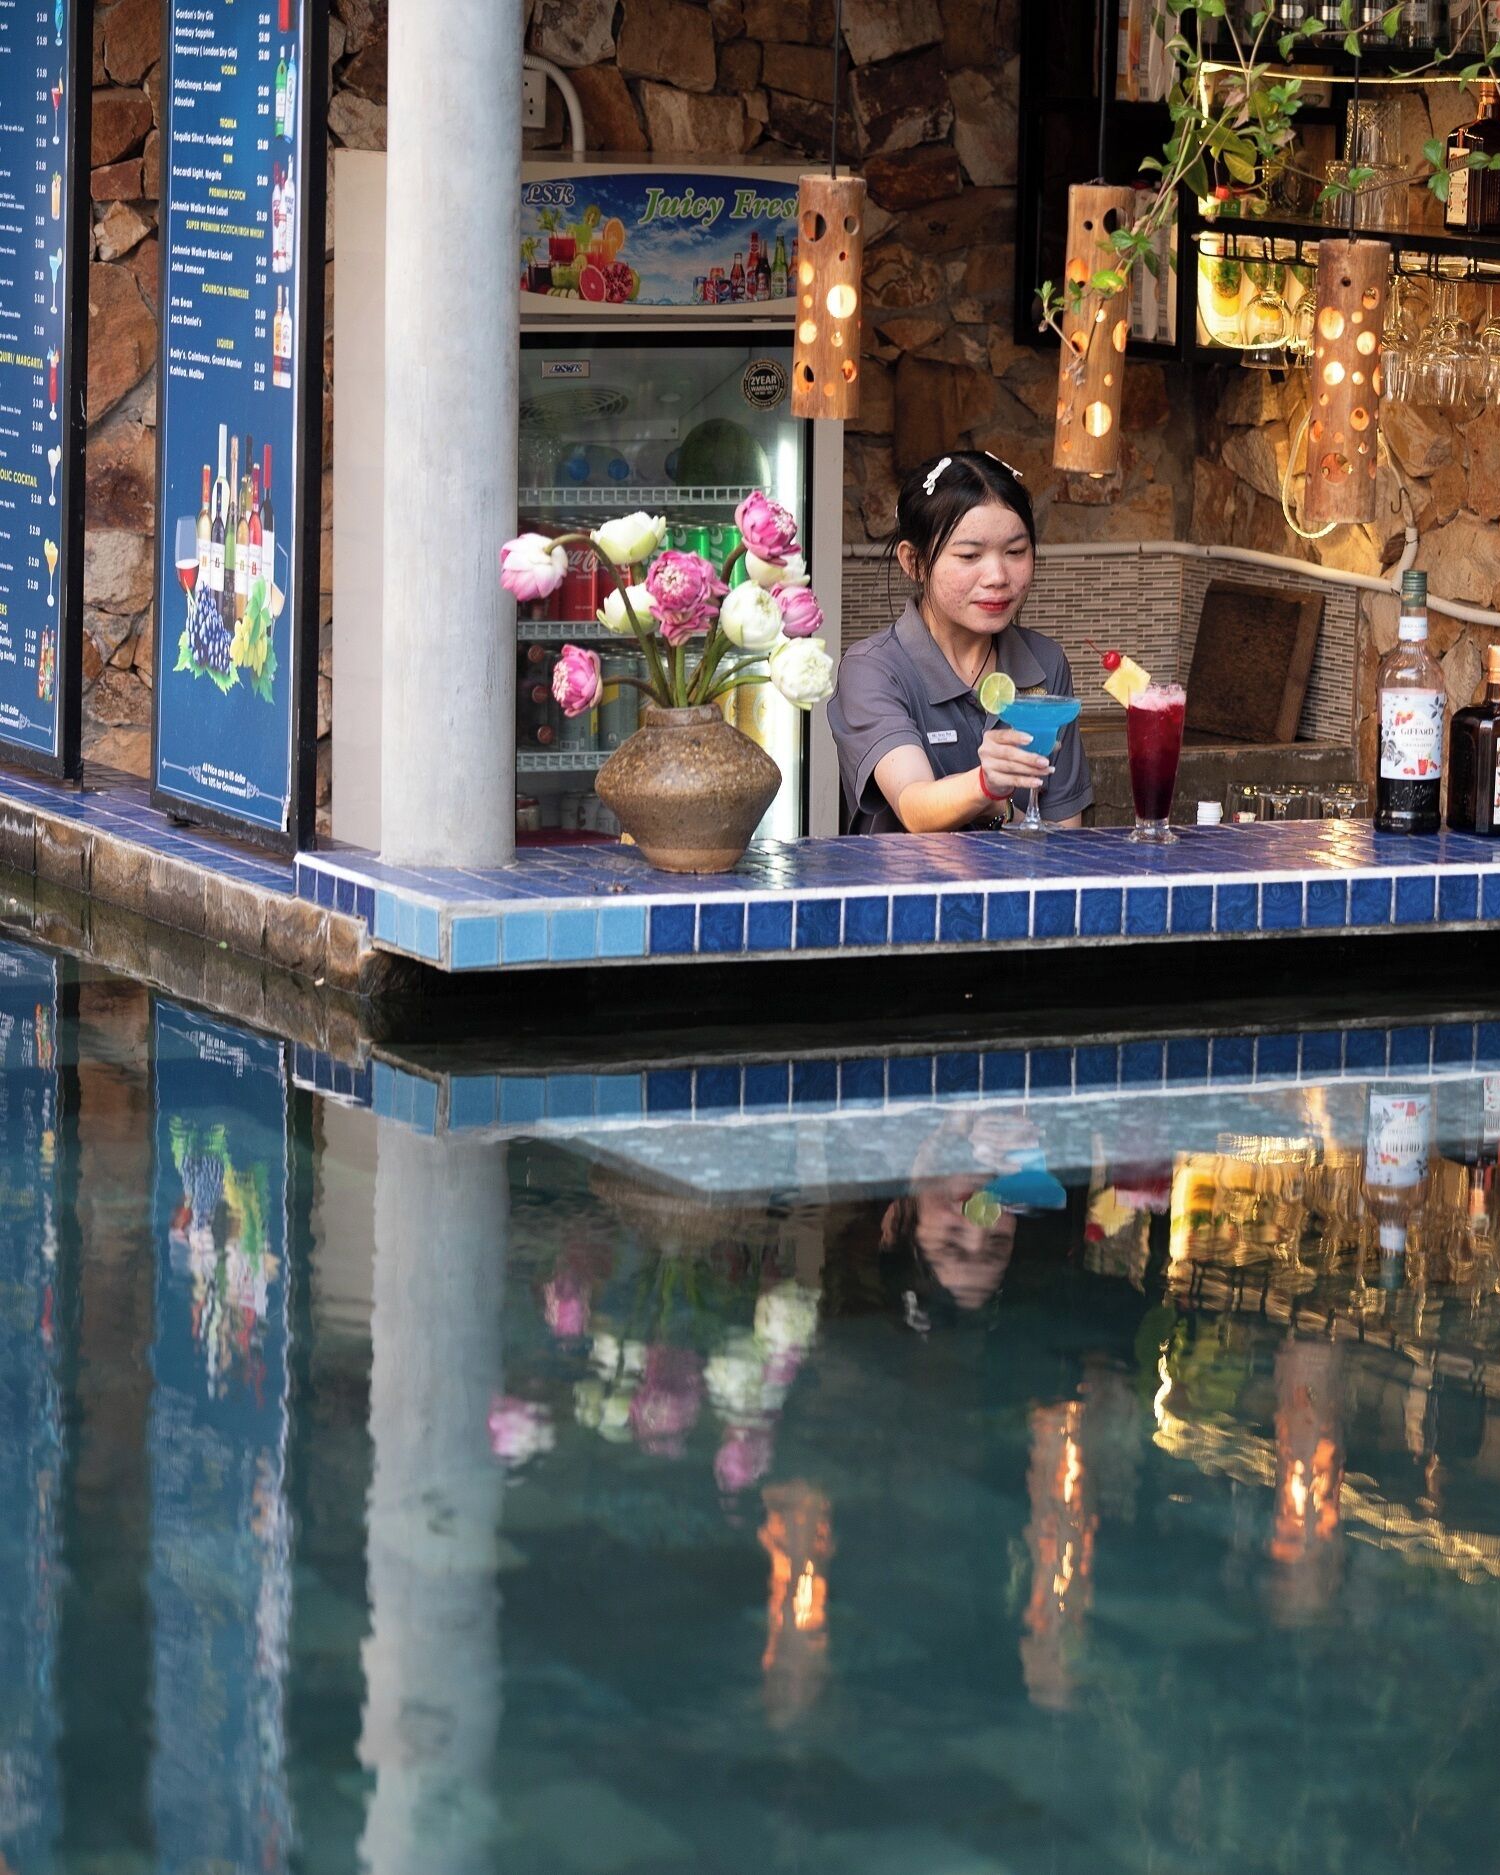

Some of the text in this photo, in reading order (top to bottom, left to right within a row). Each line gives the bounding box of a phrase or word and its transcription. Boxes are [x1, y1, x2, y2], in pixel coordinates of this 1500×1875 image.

[175, 9, 214, 22] Gordon's Dry Gin
[175, 27, 215, 39] Bombay Sapphire
[175, 44, 199, 56] Tanqueray
[220, 47, 228, 59] Dry
[221, 65, 237, 76] VODKA
[203, 81, 222, 92] Smirnoff
[174, 97, 195, 108] Absolute
[220, 118, 237, 129] TEQUILA
[174, 131, 191, 143] Tequila
[206, 134, 222, 147] Tequila
[222, 136, 234, 148] Gold
[223, 153, 233, 164] RUM
[173, 166, 192, 177] Bacardi
[205, 169, 222, 182] Negrita
[209, 187, 246, 201] PREMIUM SCOTCH
[171, 201, 229, 217] Johnnie Walker Red Label
[638, 187, 724, 227] Juicy
[186, 219, 200, 230] SUPER
[200, 221, 220, 234] PREMIUM
[249, 227, 265, 239] WHISKY
[172, 244, 233, 262] Johnnie Walker Black Label
[172, 262, 205, 275] John Jameson
[202, 283, 223, 295] BOURBON
[227, 286, 249, 299] TENNESSEE
[171, 296, 180, 307] Jim
[171, 314, 202, 328] Jack Daniel's
[216, 338, 234, 350] LIQUEUR
[212, 355, 225, 367] Grand
[226, 357, 242, 369] Marnier
[188, 368, 205, 380] Malibu
[208, 764, 217, 775] Price
[229, 770, 235, 781] US
[235, 772, 246, 785] dollar
[222, 782, 247, 797] Government
